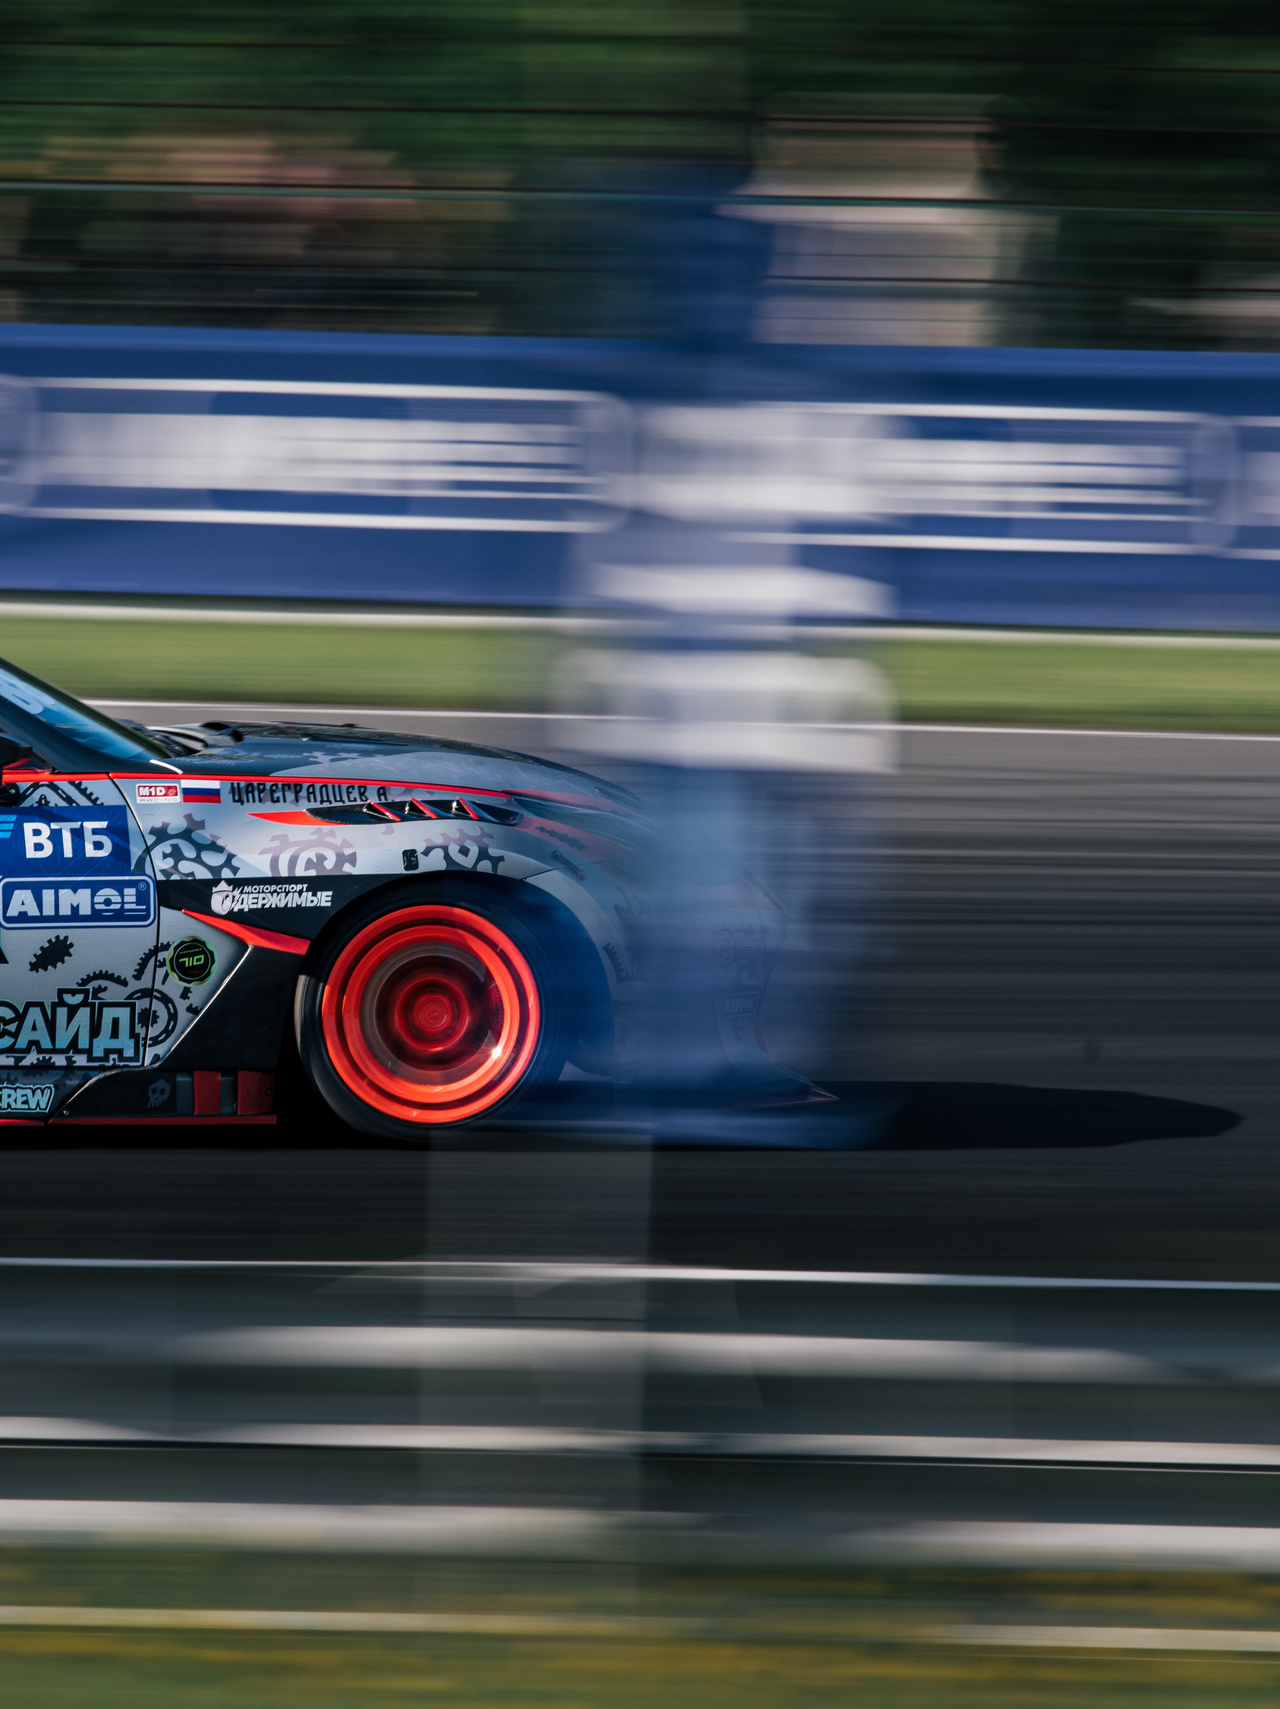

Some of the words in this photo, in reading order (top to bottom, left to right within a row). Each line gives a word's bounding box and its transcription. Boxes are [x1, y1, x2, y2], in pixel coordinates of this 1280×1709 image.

[139, 786, 166, 796] M1D
[230, 782, 369, 806] ЦАРЕГРАДЦЕВ
[23, 820, 113, 859] ВТБ
[243, 884, 308, 894] МОТОРСПОРТ
[5, 887, 147, 917] AIMOL
